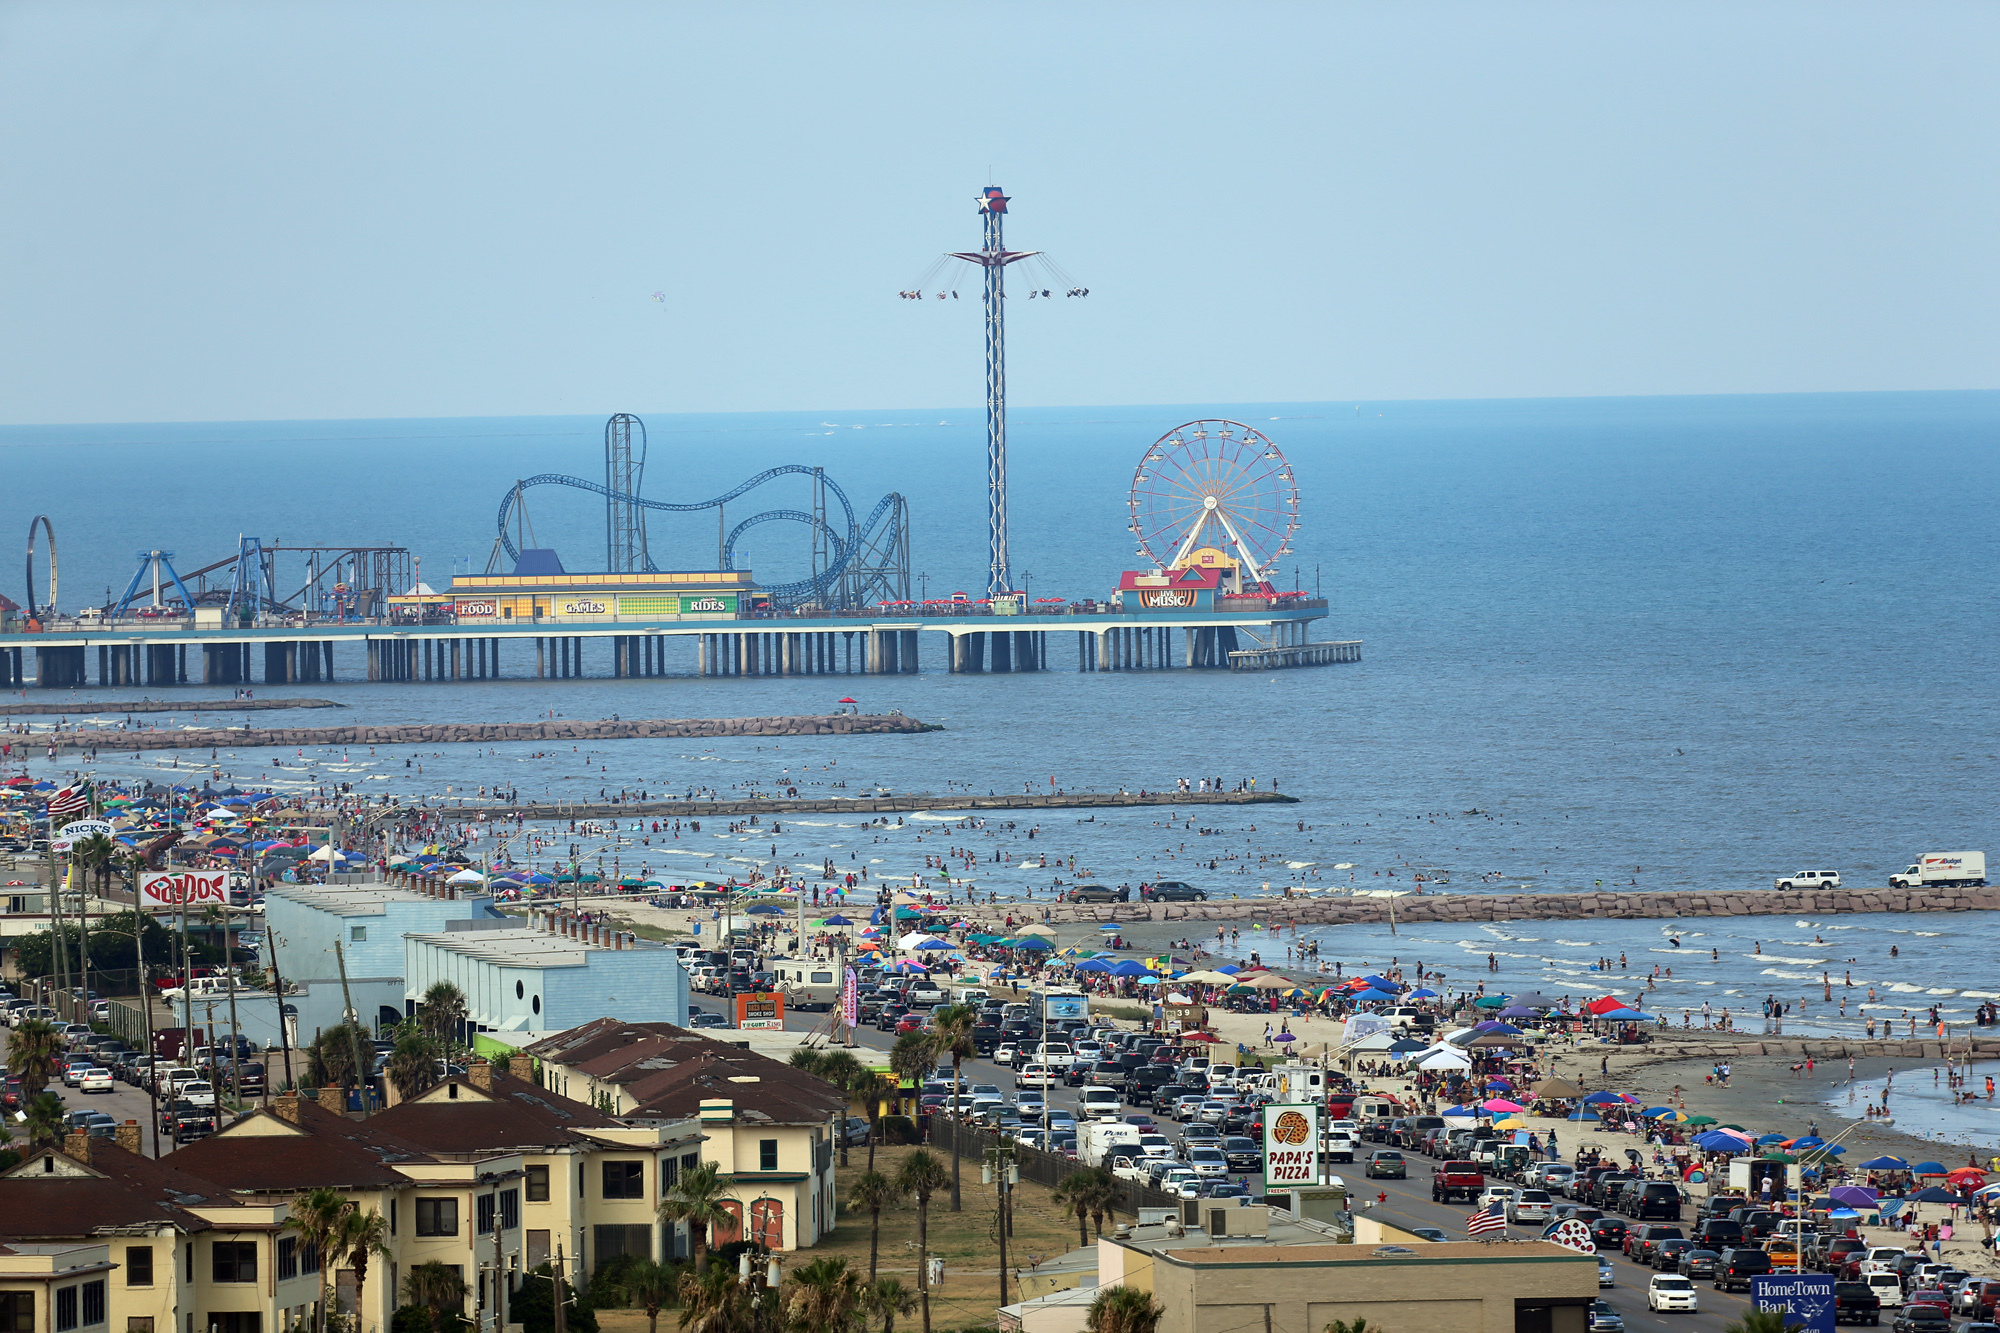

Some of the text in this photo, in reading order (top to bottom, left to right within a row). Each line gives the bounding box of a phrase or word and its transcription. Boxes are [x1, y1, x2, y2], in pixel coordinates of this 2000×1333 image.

[691, 601, 726, 611] RIDES
[1149, 596, 1185, 606] MUSIC
[461, 604, 493, 615] FOOD
[564, 602, 605, 613] GAMES
[64, 824, 111, 835] NICK'S
[1268, 1151, 1314, 1165] PAPA'S
[1273, 1166, 1310, 1180] PIZZA
[1758, 1281, 1831, 1296] HomeTown
[1759, 1299, 1796, 1314] Bank
